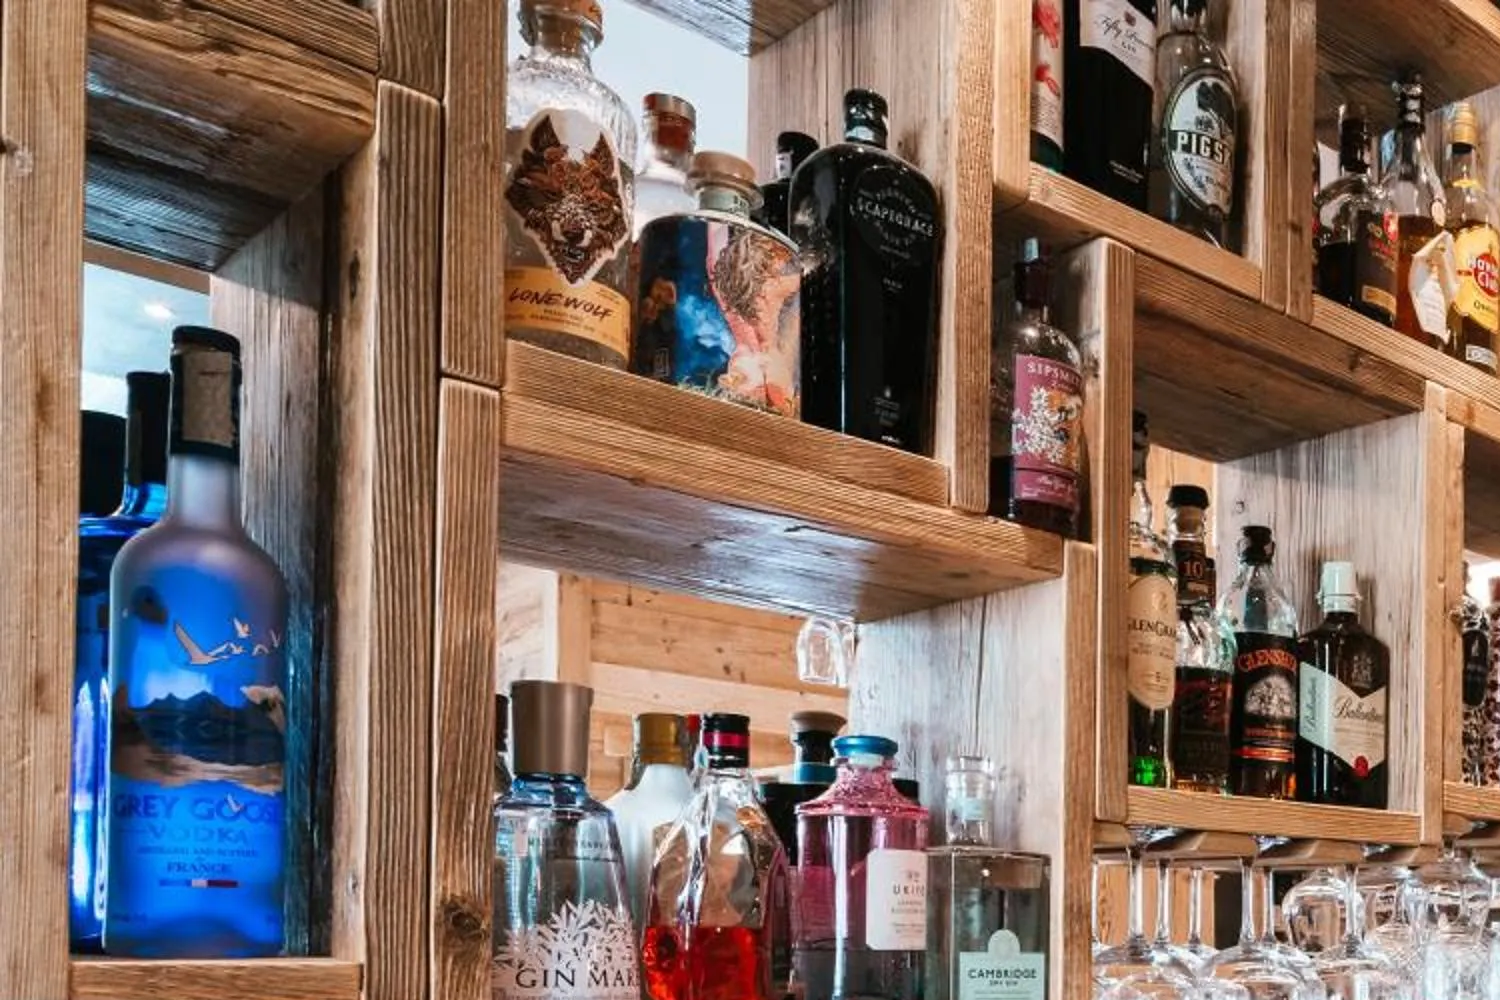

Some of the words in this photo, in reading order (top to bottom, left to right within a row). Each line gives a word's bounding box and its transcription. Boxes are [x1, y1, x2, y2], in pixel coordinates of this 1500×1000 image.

[113, 794, 180, 820] GREY
[148, 823, 250, 844] VODKA
[166, 862, 233, 874] FRANCE
[515, 967, 576, 988] GIN
